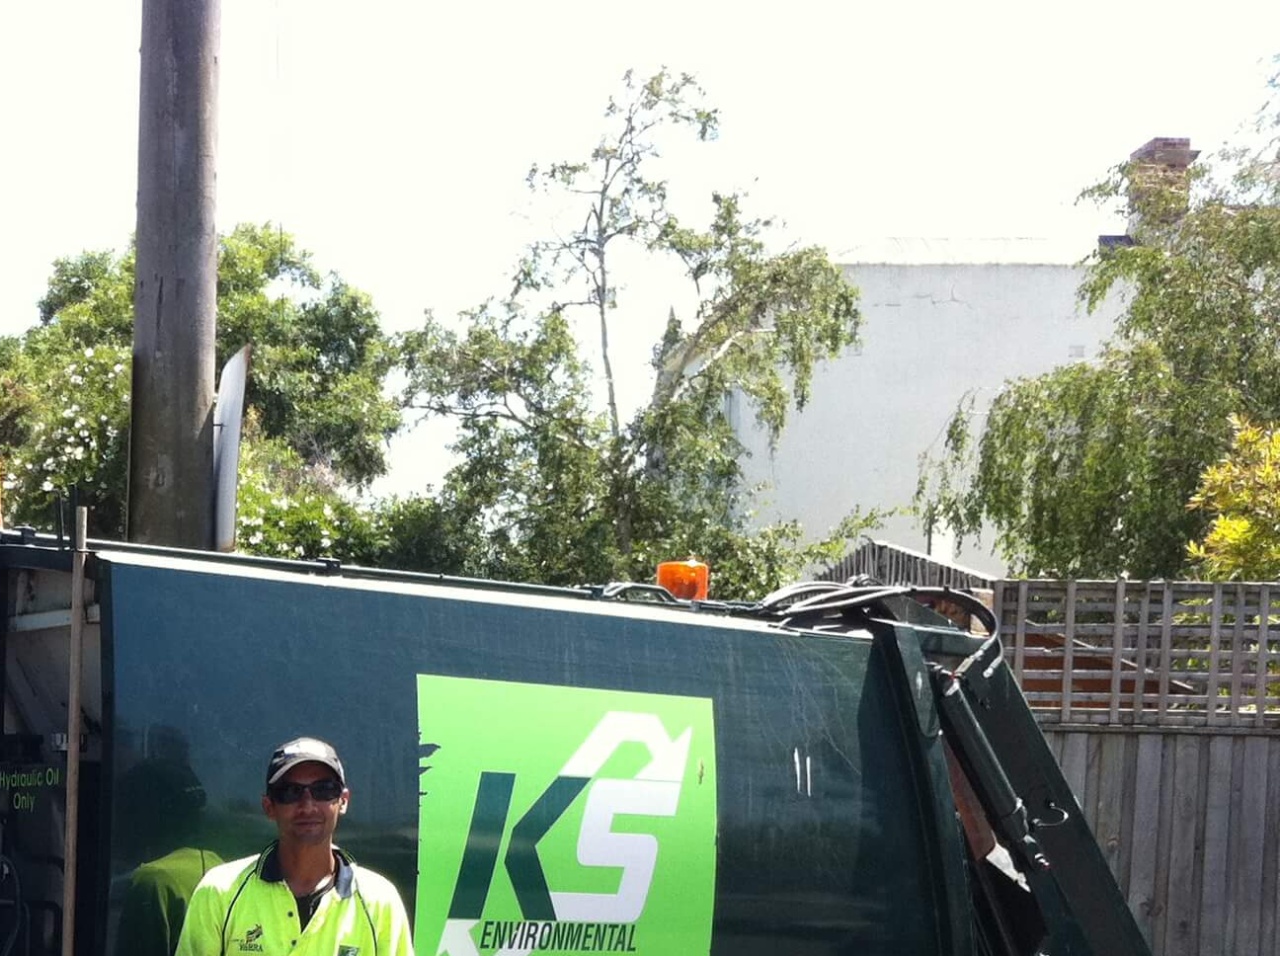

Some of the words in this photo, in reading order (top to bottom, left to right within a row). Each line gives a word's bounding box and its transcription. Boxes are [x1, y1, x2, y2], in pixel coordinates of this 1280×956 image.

[0, 769, 43, 791] Hydraulic
[45, 767, 60, 786] Oil
[12, 792, 36, 812] Only
[445, 711, 691, 924] KS
[479, 920, 637, 953] ENVIRONMENTAL
